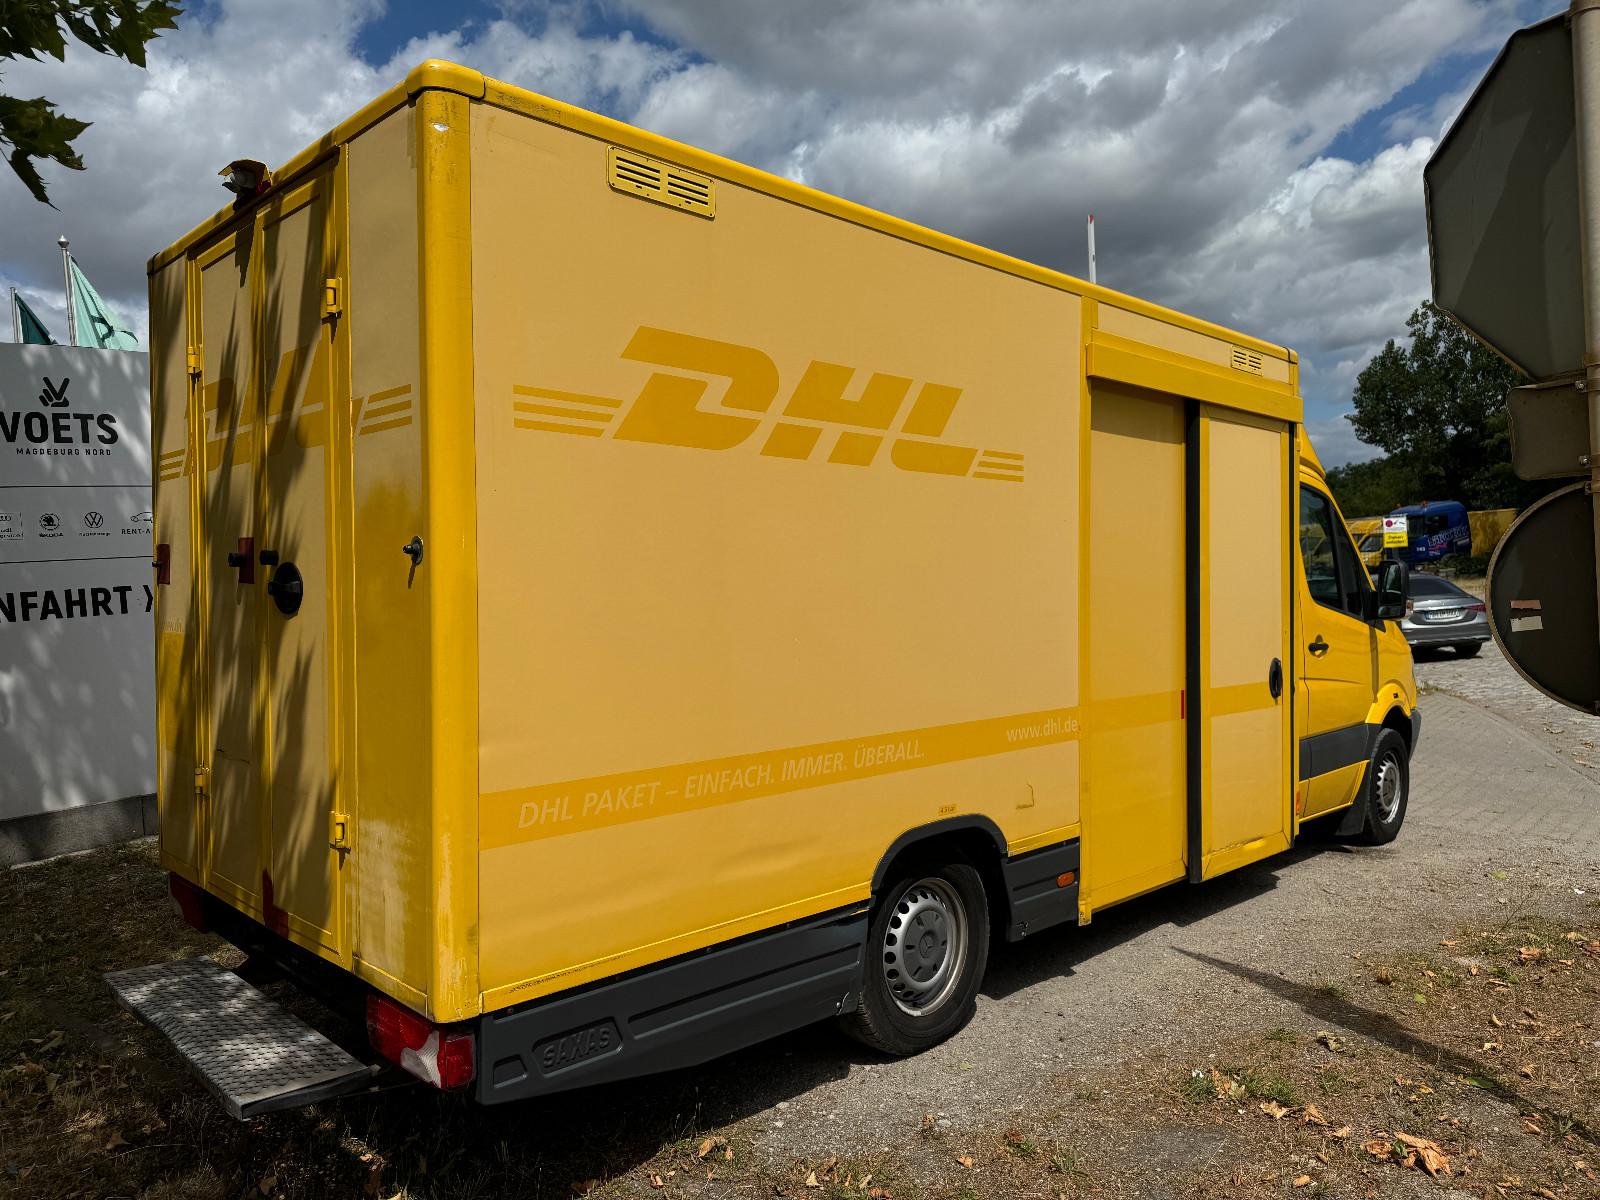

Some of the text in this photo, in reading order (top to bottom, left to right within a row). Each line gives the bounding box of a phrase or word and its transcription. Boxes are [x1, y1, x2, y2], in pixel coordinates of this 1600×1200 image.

[612, 325, 978, 477] DHL
[0, 411, 119, 444] VOETS
[16, 448, 80, 456] MAGDEBURG
[1006, 718, 1079, 743] www.dhl.de
[517, 799, 574, 830] DHL
[581, 781, 662, 818] PAKET
[684, 762, 775, 799] EINFACH.
[781, 752, 847, 782] IMMER.
[853, 738, 926, 770] ÜBERALL.
[543, 1027, 610, 1068] SAXAS
